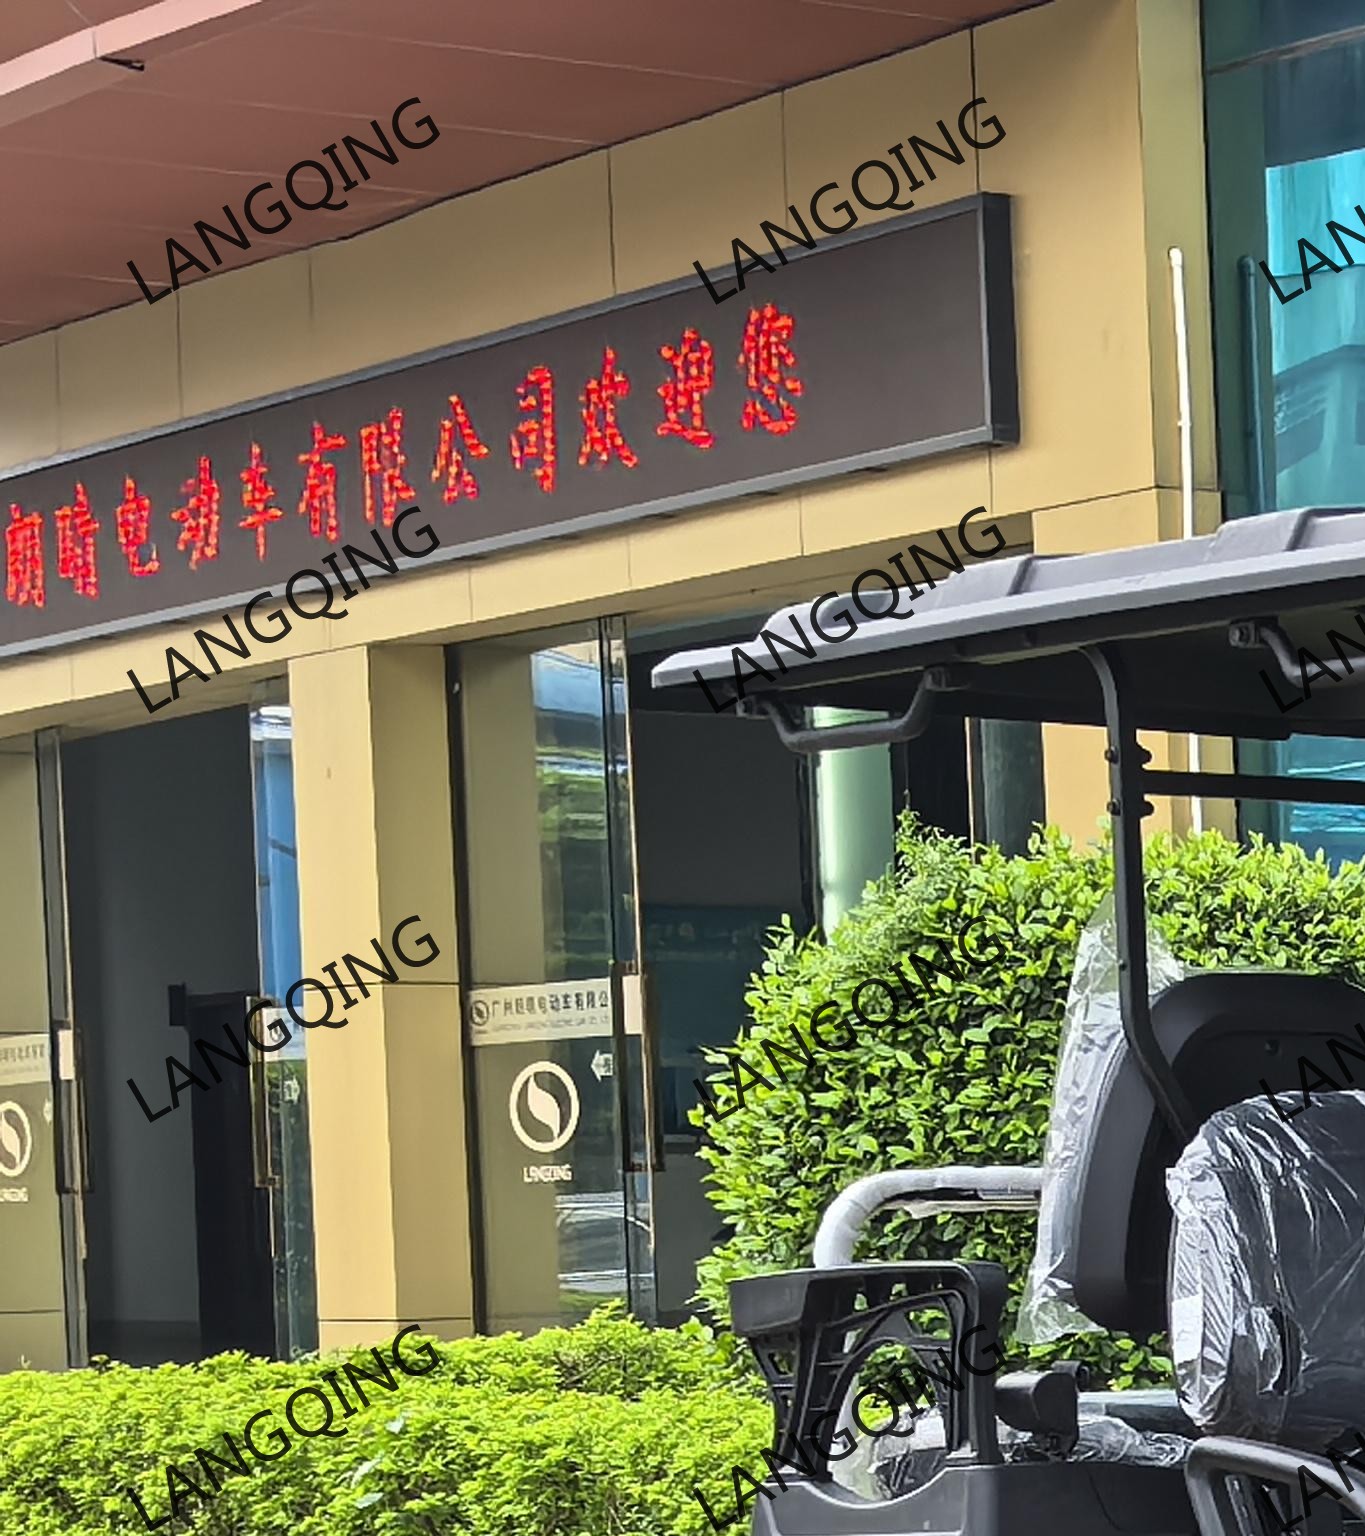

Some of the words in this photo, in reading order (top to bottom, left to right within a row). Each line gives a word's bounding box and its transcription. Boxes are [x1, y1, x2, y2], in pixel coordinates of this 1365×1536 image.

[5, 303, 804, 608] 朗晴电动车有限公司欢迎您
